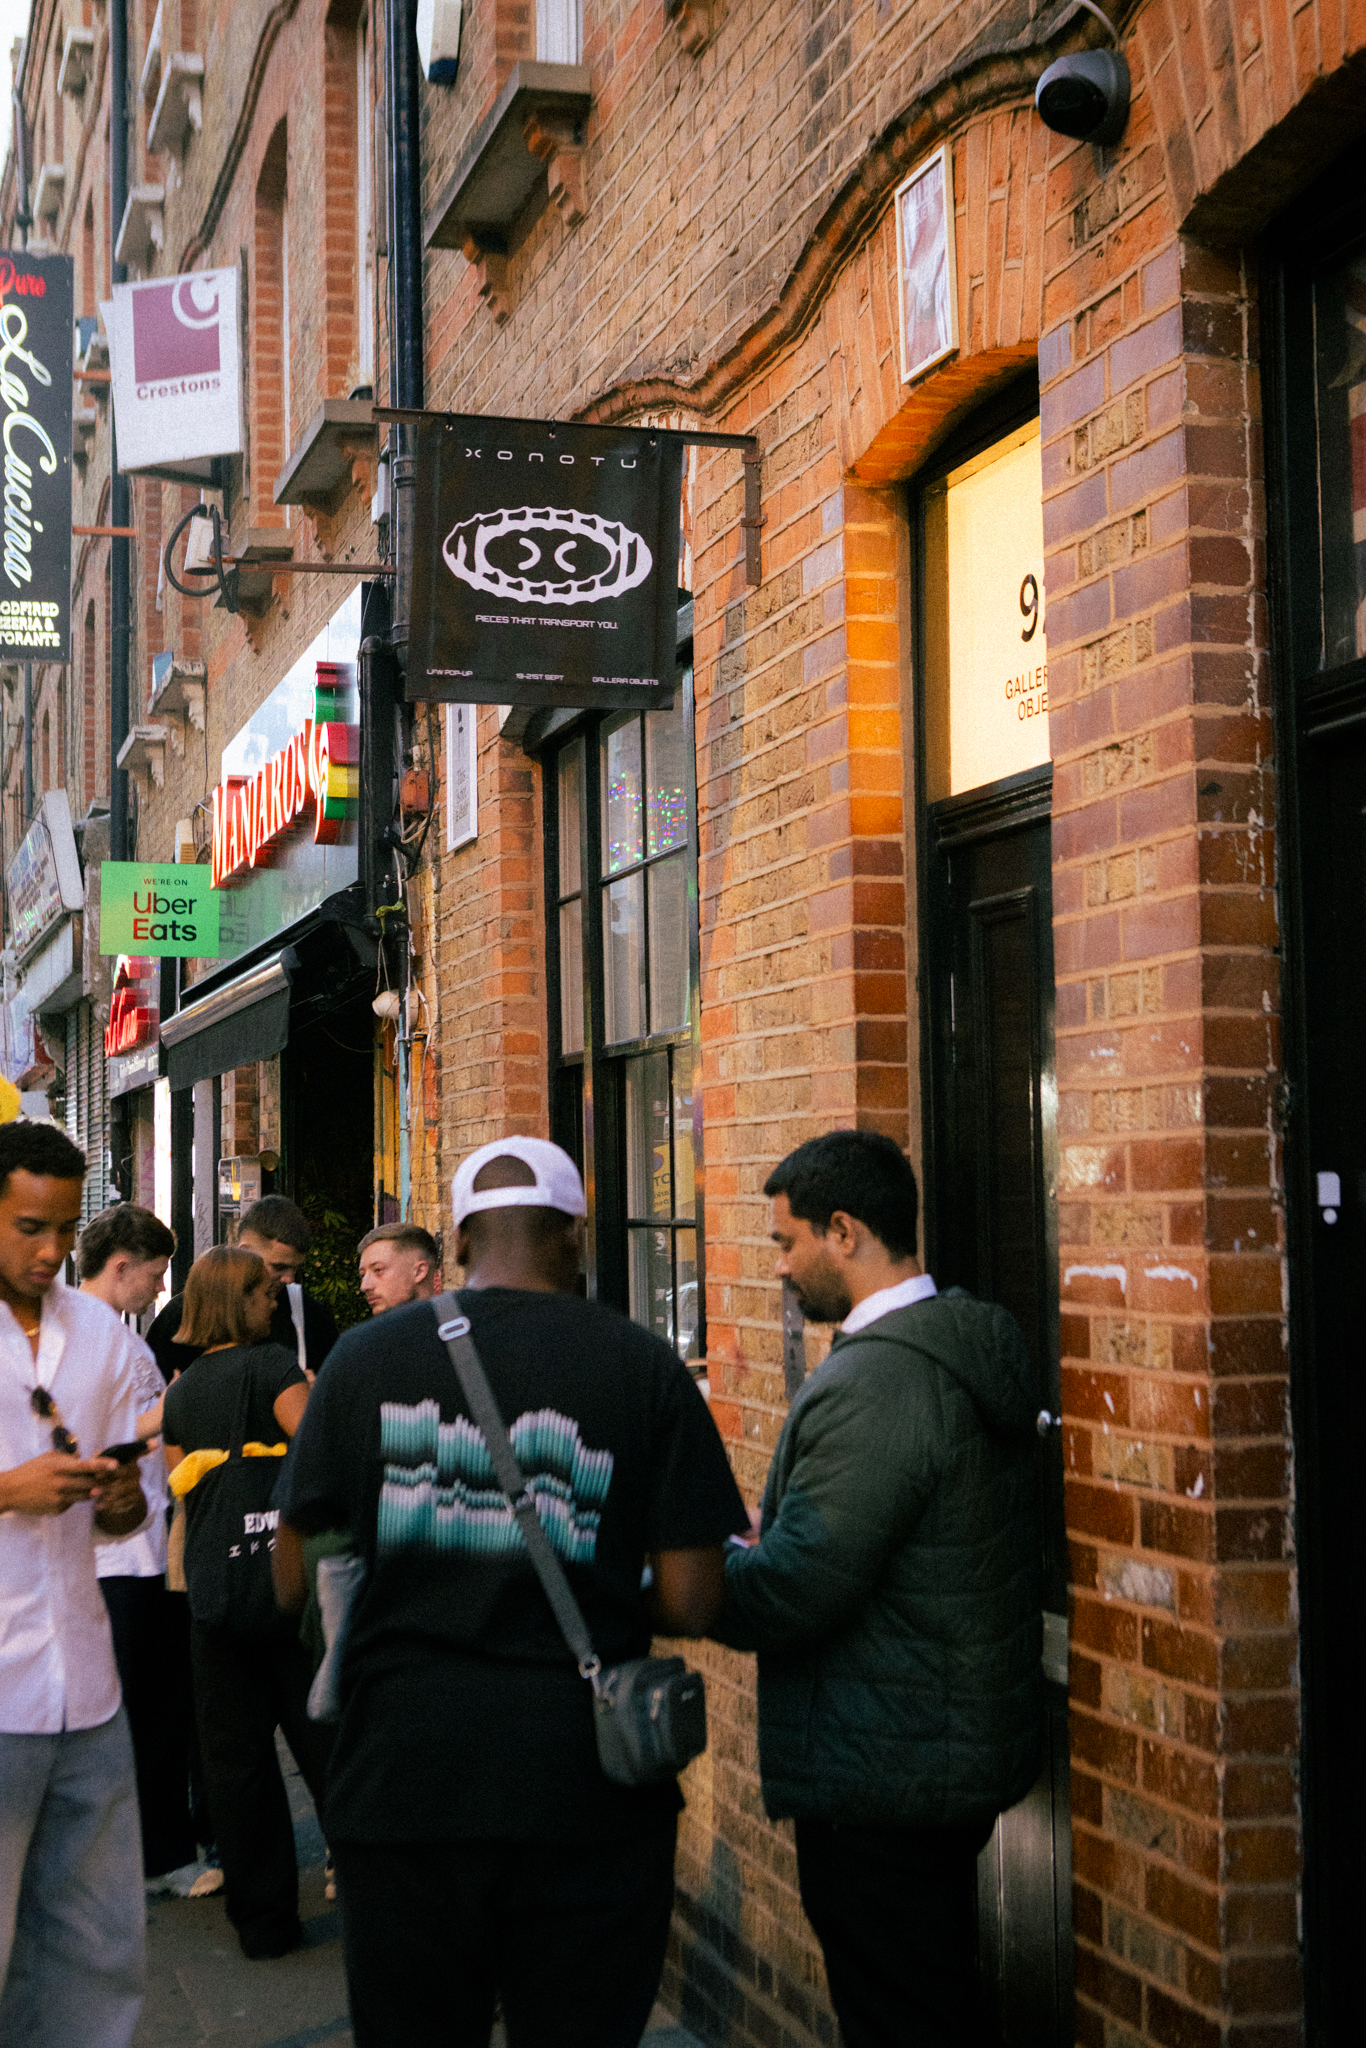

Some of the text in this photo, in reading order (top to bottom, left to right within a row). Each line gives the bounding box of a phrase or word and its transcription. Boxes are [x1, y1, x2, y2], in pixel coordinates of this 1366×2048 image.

[136, 378, 220, 400] Crestons
[3, 411, 57, 588] Cucina
[475, 614, 618, 630] PIECES THAT TRANSPORT YOU.
[592, 676, 659, 686] GALLERIA OBJETS
[143, 878, 171, 886] WE'RE
[133, 891, 197, 915] Uber
[133, 918, 197, 941] Eats
